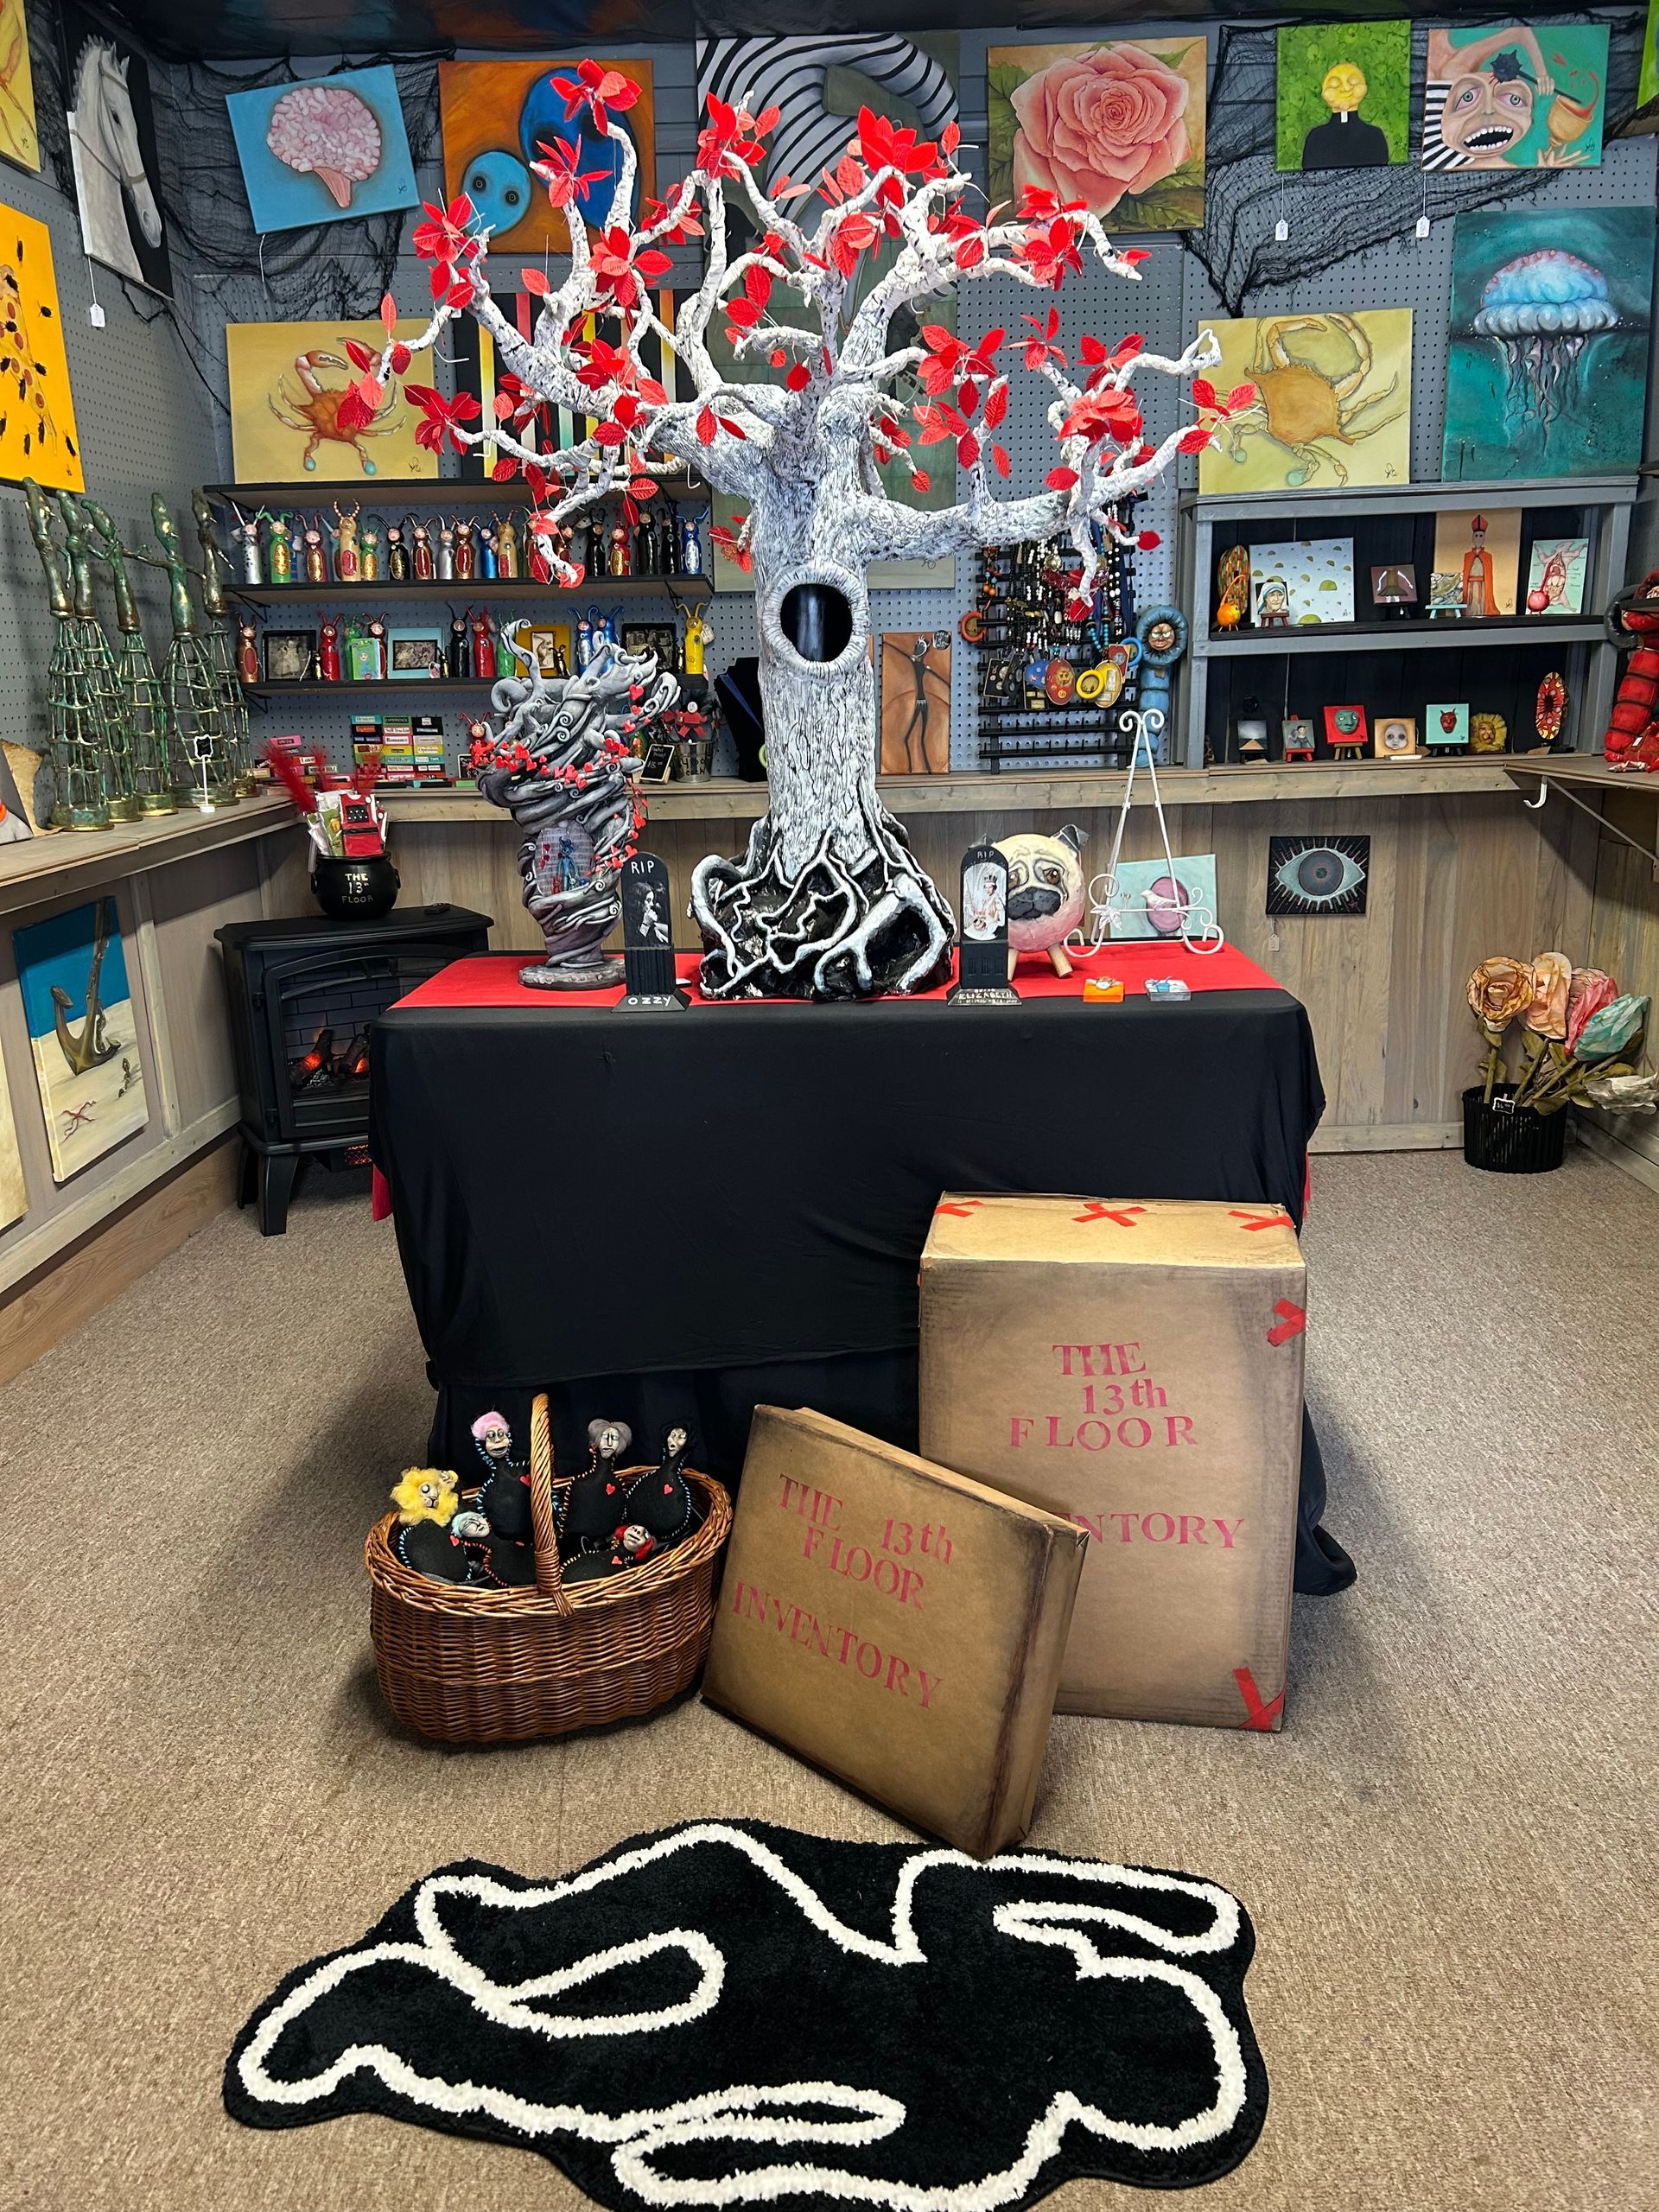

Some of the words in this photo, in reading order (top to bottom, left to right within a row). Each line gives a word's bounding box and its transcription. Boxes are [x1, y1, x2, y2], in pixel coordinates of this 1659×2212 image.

[631, 861, 655, 874] RIP
[977, 851, 994, 860] RIP
[342, 895, 373, 903] FLOOR
[628, 995, 671, 1007] OZZY
[1052, 1342, 1147, 1378] THE
[1083, 1377, 1168, 1415] 13th
[1009, 1415, 1199, 1451] FLOOR
[779, 1472, 844, 1532] THE
[880, 1517, 955, 1566] 13th
[1056, 1512, 1245, 1549] NTORY
[802, 1527, 925, 1611] FLOOR
[731, 1580, 944, 1710] INVENTORY
